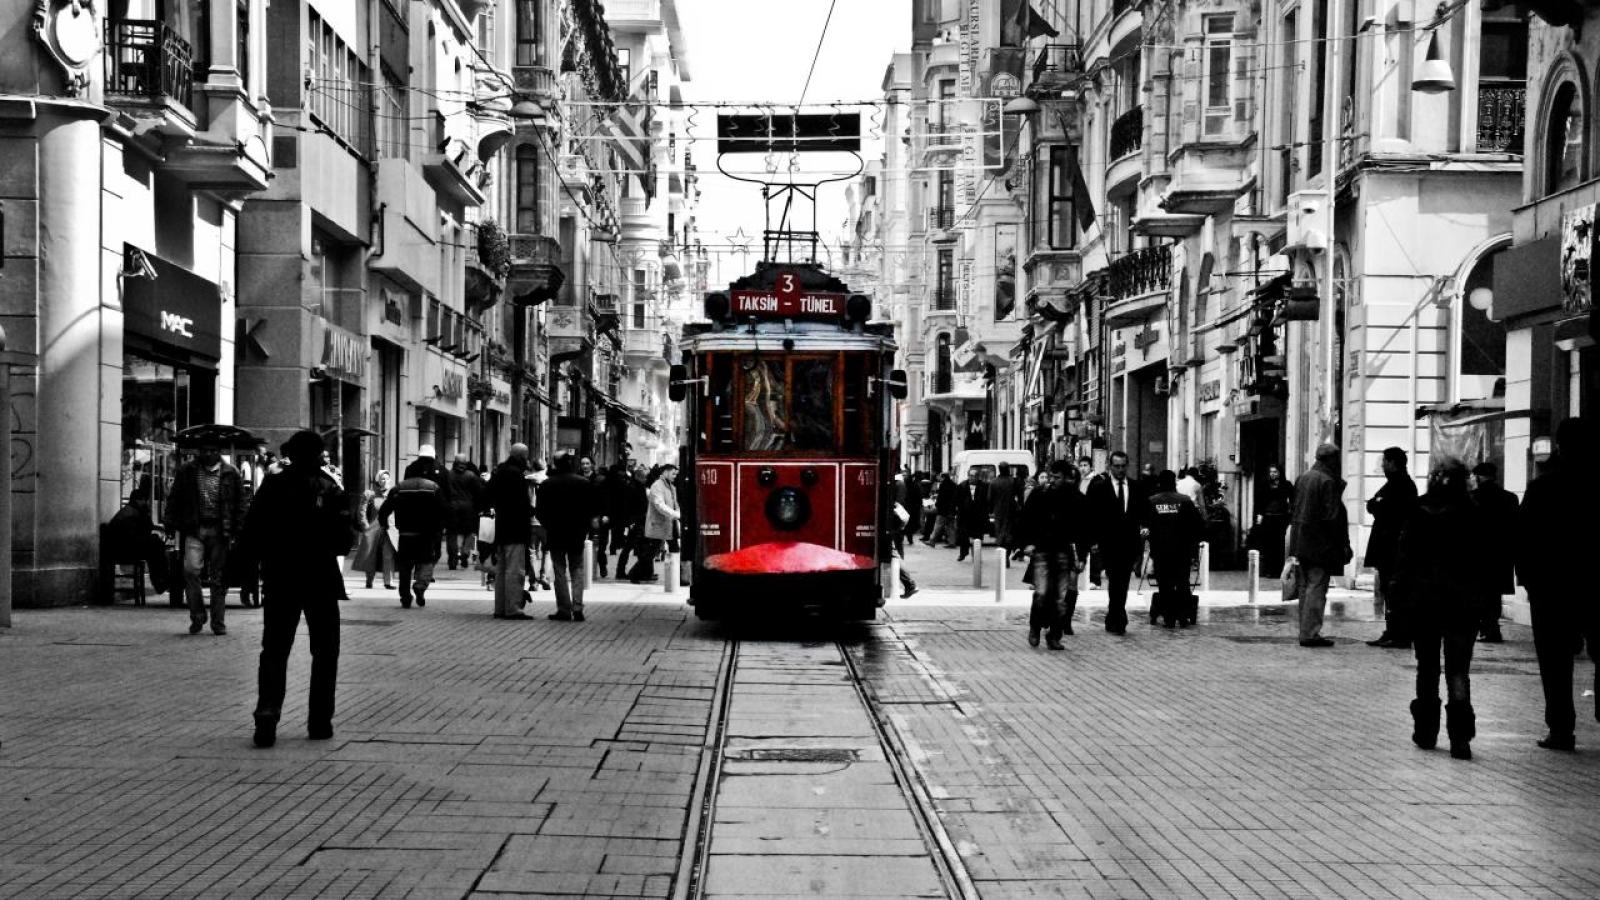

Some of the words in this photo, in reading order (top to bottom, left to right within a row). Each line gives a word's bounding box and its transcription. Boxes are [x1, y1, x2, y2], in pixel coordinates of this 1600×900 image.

[782, 274, 794, 293] 3
[799, 295, 837, 313] TÜNEL
[160, 310, 194, 339] MAC
[701, 468, 717, 485] 410
